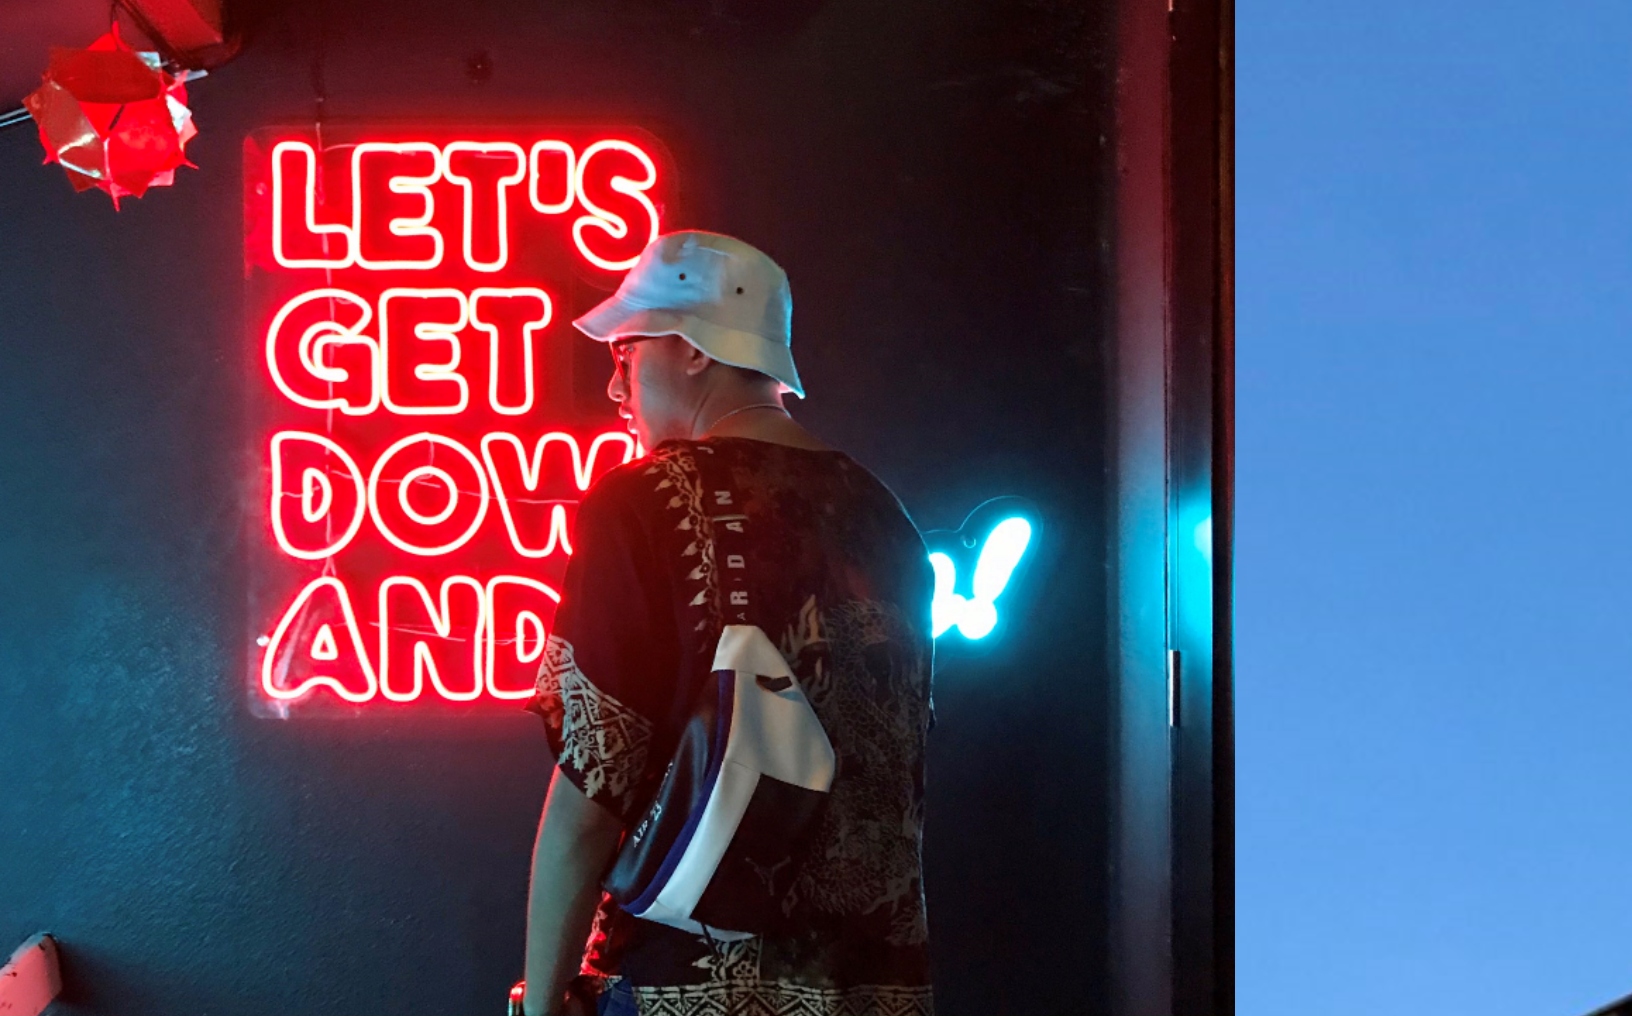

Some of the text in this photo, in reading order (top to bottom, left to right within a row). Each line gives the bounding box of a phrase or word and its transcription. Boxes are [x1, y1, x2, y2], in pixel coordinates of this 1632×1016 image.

[271, 140, 660, 271] LET'S
[266, 287, 552, 415] GET
[262, 575, 561, 702] AND
